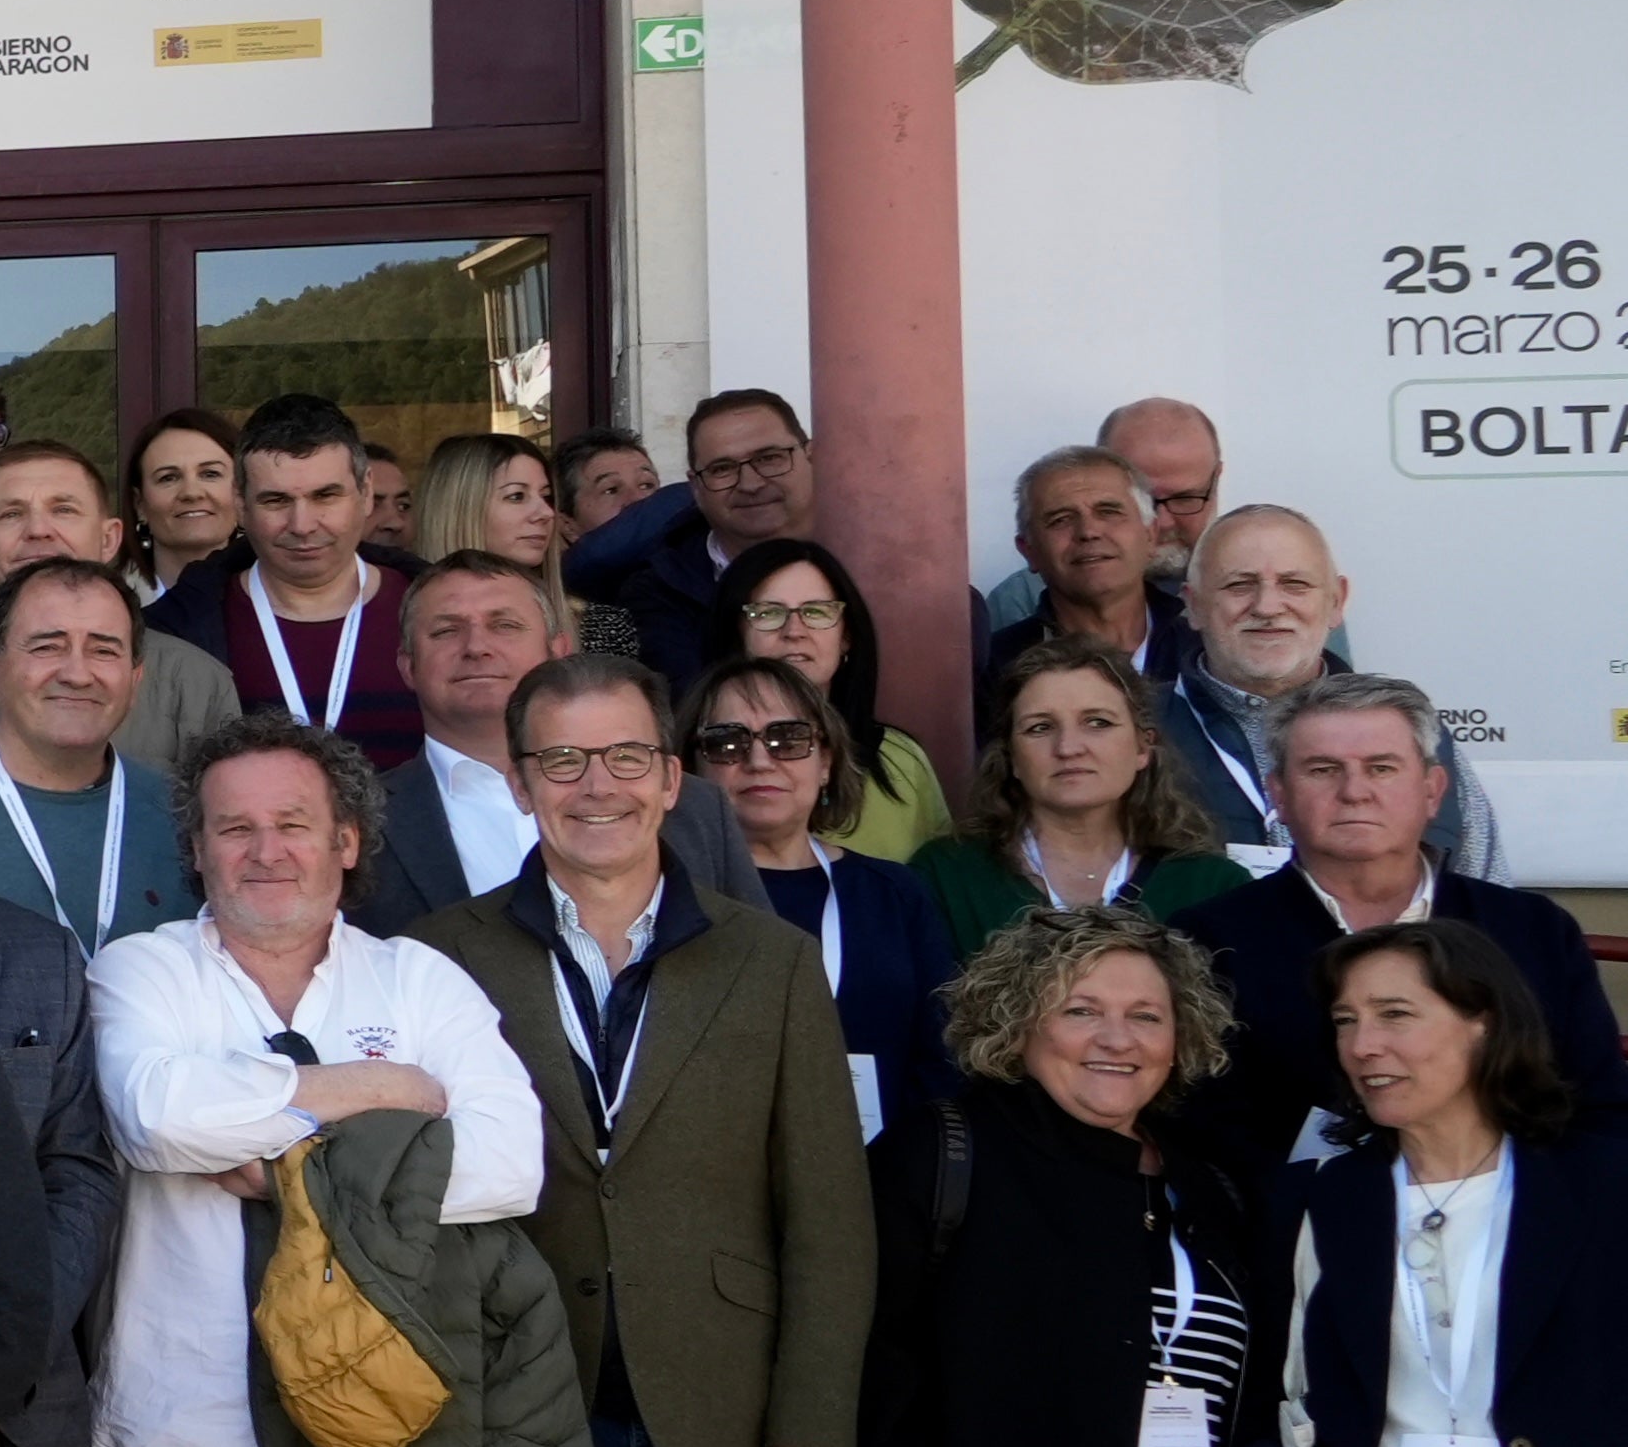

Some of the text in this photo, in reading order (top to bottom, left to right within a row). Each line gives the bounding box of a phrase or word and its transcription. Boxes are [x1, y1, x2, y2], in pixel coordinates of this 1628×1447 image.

[1388, 310, 1601, 356] marzo
[1421, 405, 1628, 457] BOLT
[1453, 727, 1506, 742] GON
